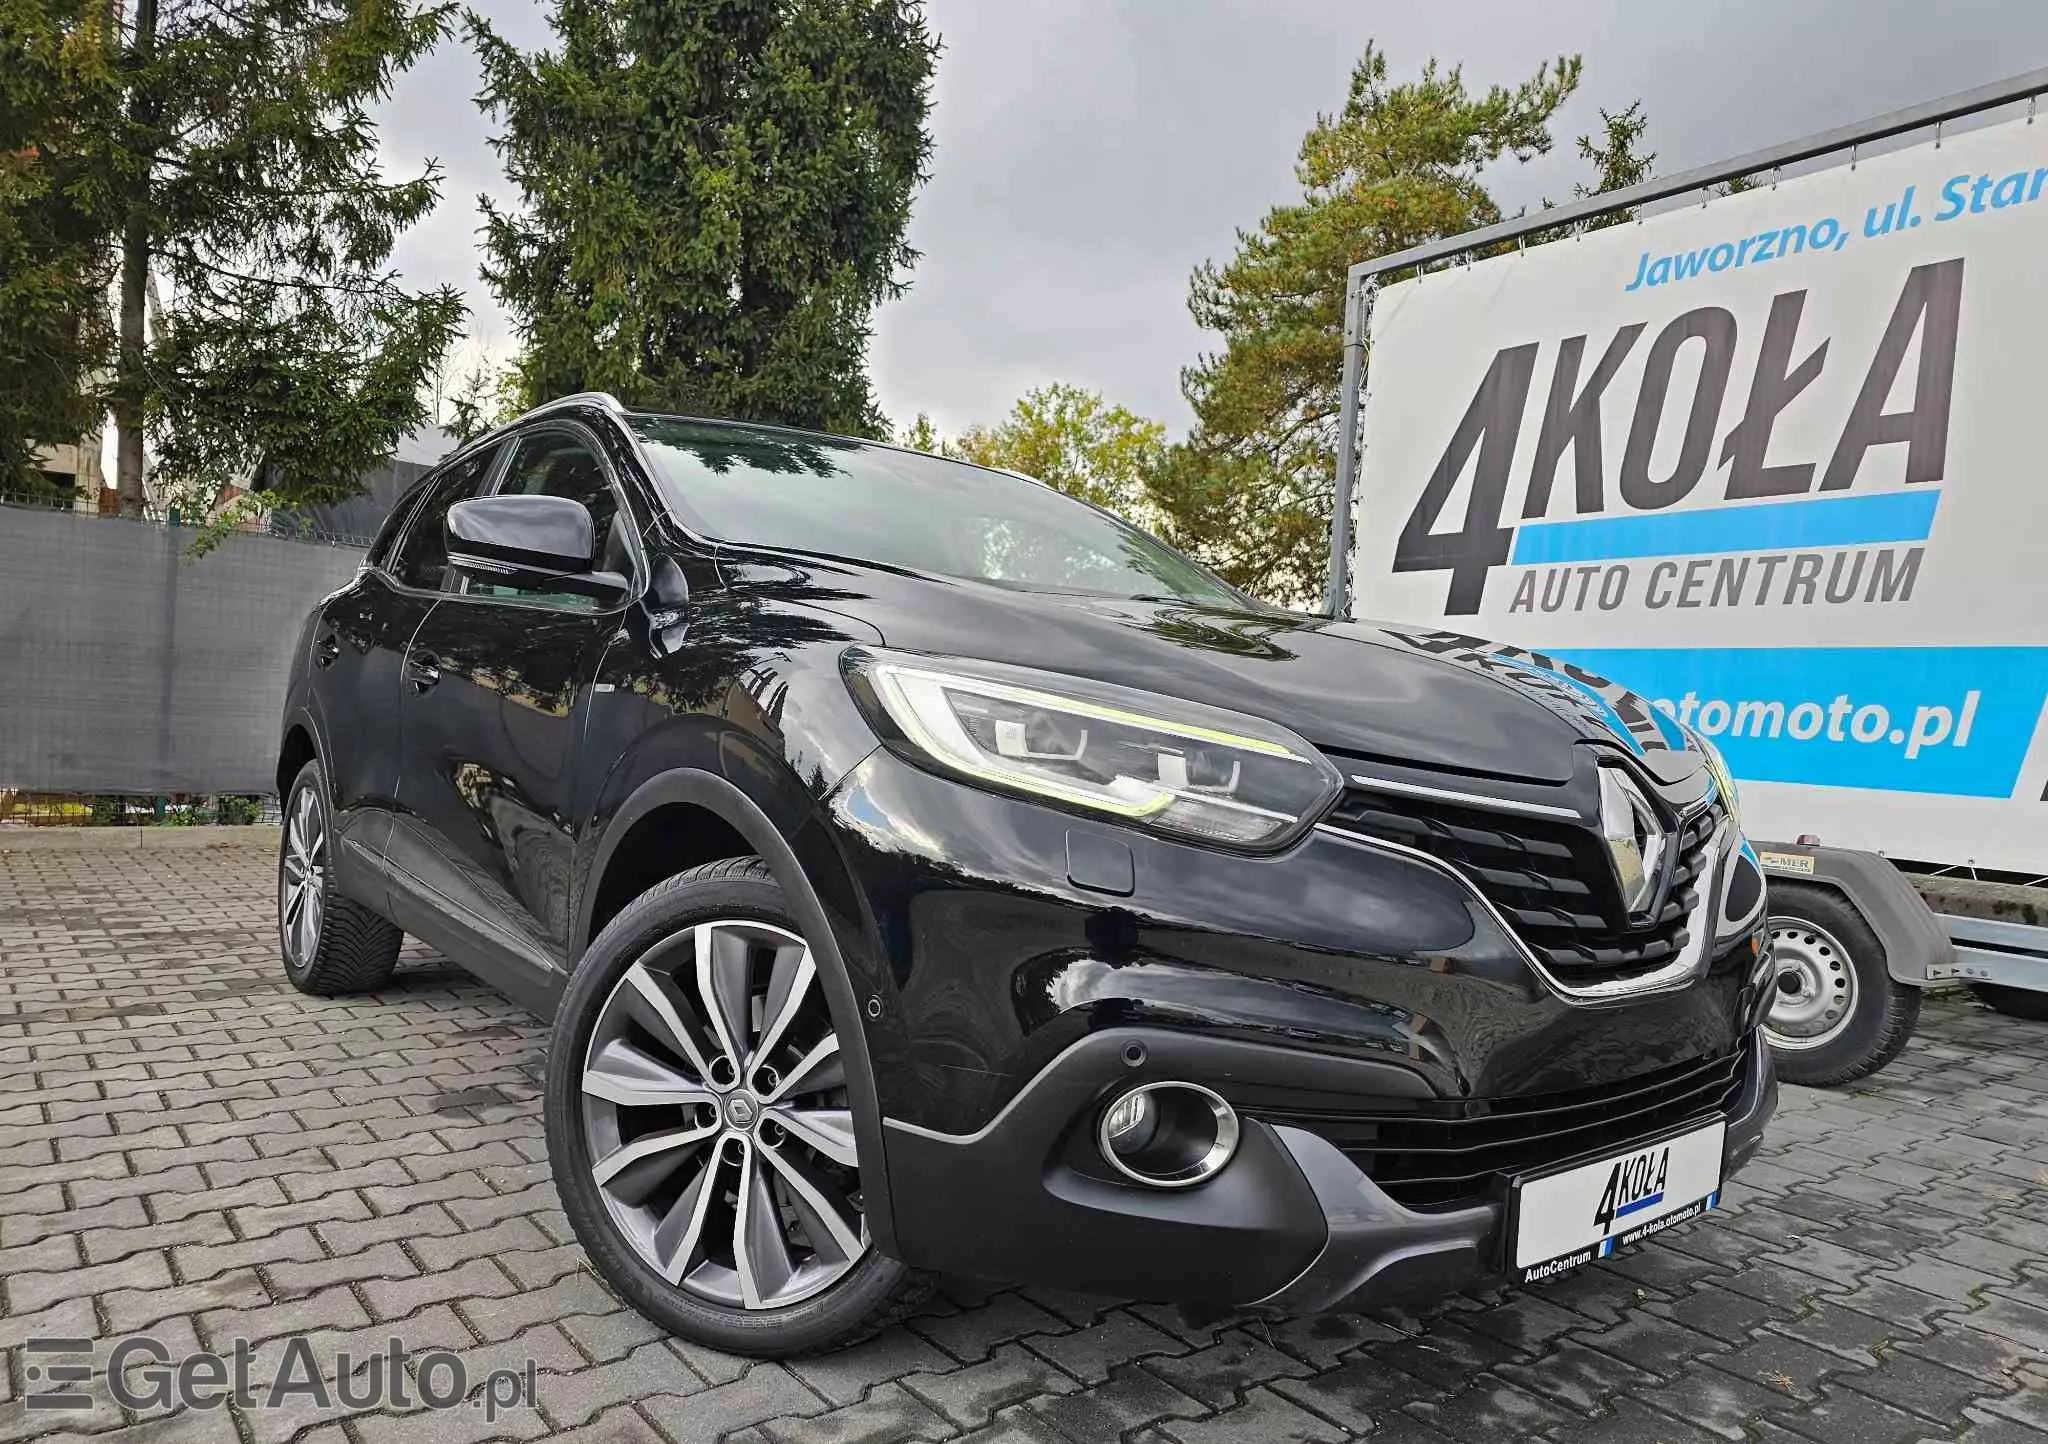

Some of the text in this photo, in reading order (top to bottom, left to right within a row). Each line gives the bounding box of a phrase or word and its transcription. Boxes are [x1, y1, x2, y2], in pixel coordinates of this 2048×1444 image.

[1625, 217, 1849, 291] Jaworzno,
[1863, 185, 1921, 238] ul.
[1508, 547, 1925, 613] AUTO CENTRUM
